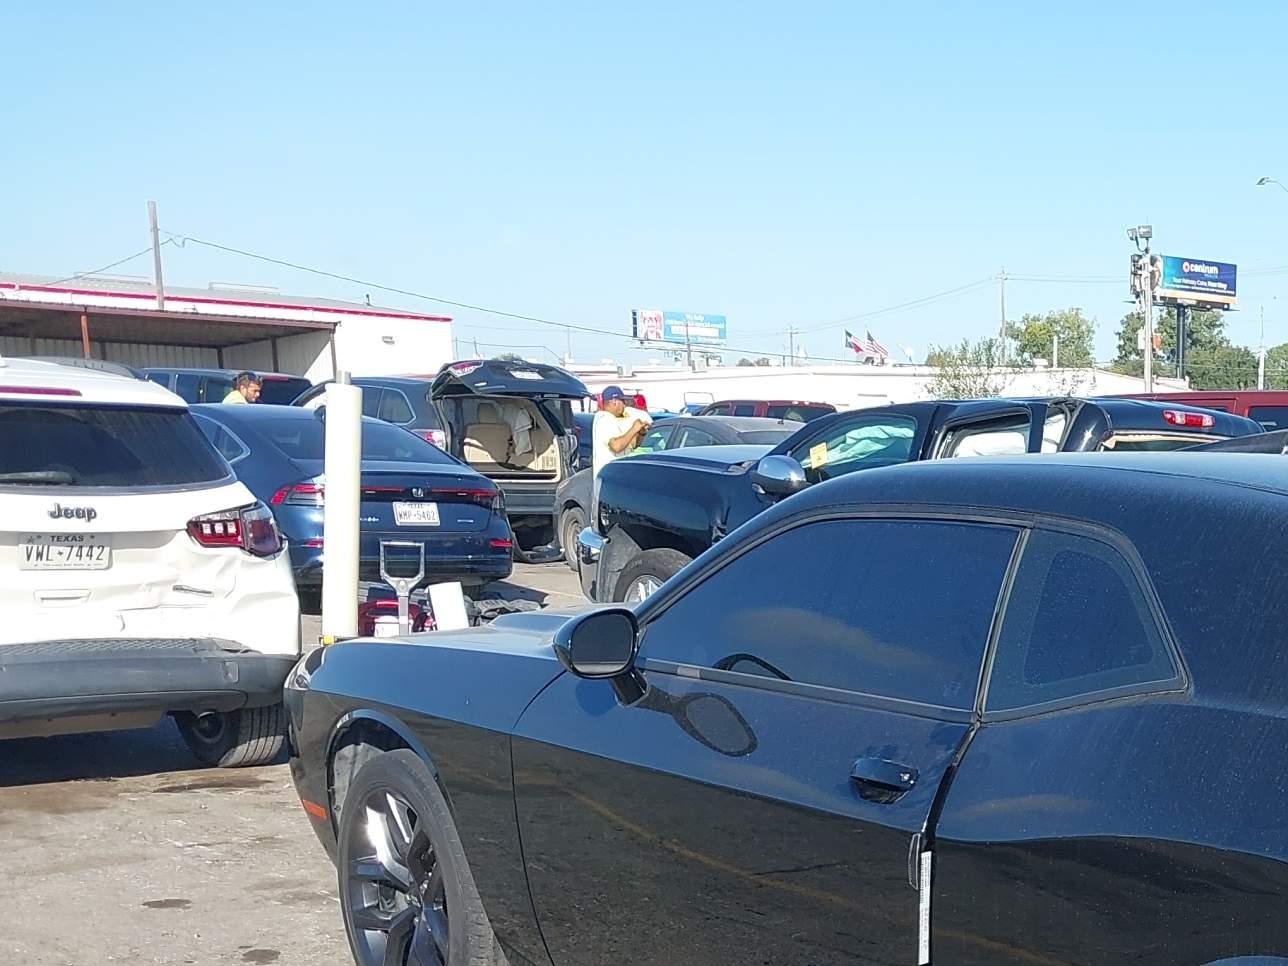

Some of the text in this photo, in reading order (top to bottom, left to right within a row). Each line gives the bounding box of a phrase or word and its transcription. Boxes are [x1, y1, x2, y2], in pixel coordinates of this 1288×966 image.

[48, 502, 97, 523] Jeep
[25, 545, 105, 562] VWL 7442
